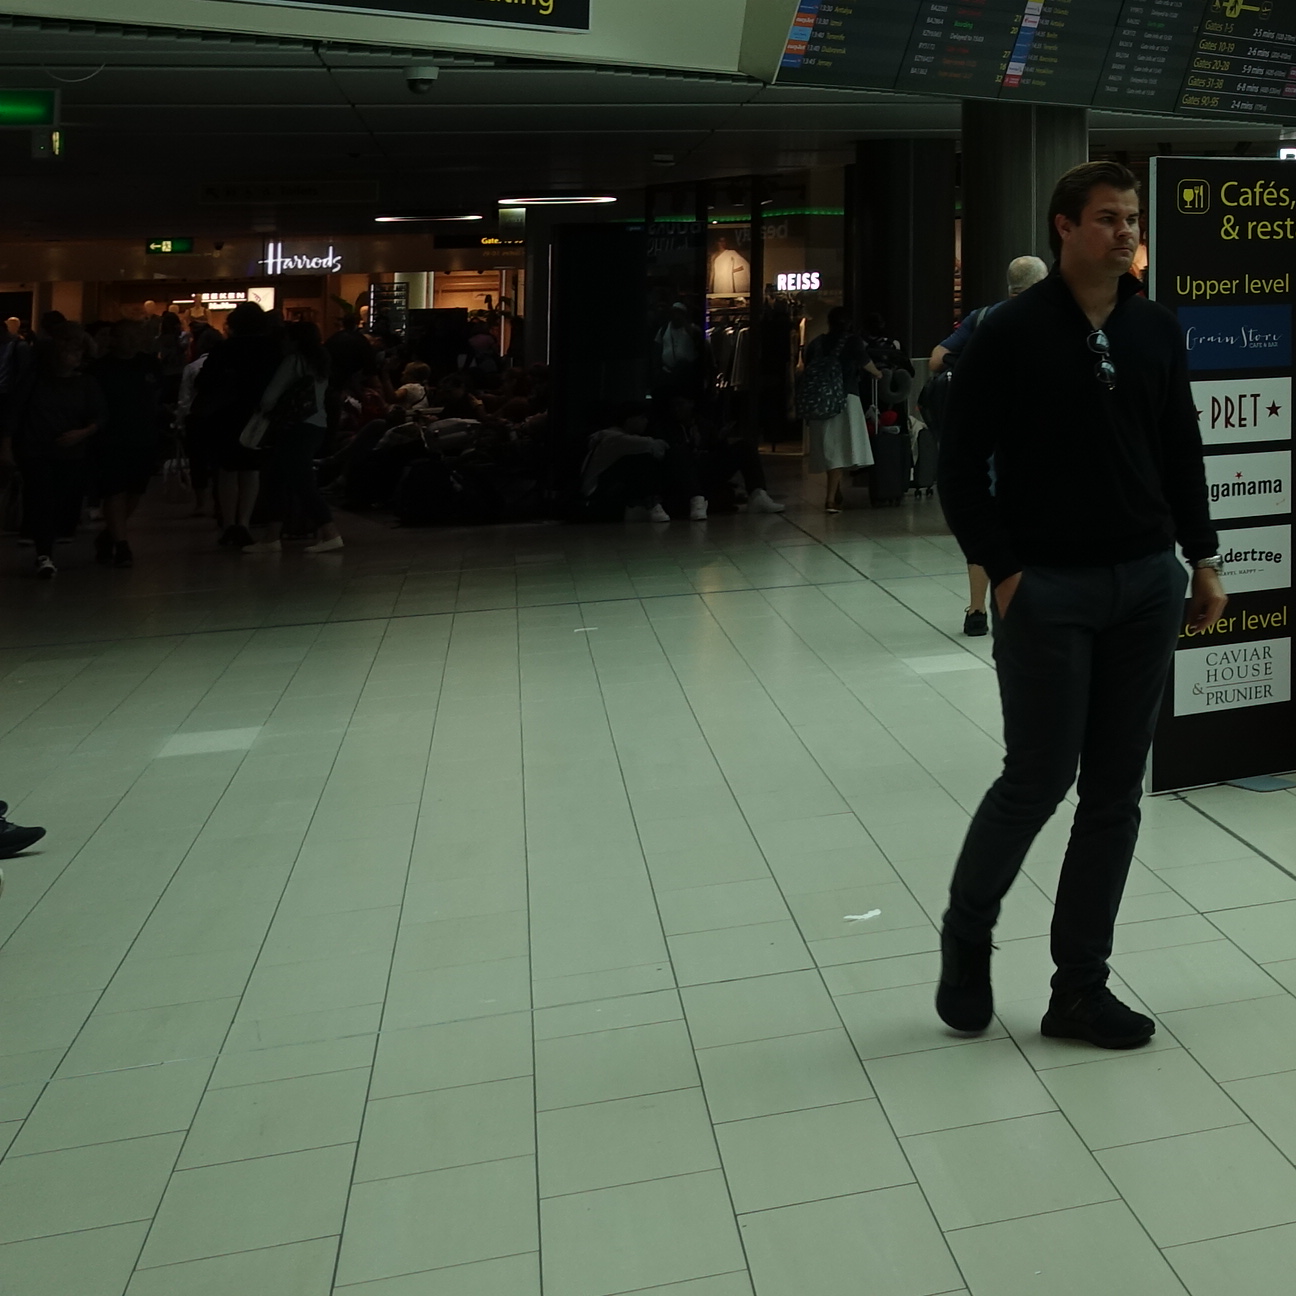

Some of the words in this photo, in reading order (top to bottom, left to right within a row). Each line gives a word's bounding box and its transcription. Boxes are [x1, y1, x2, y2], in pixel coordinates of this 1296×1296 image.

[1205, 19, 1223, 32] Gates
[1224, 22, 1234, 33] 1-5
[1199, 38, 1217, 50] Gates
[1219, 40, 1235, 53] 10-19
[1193, 57, 1211, 69] Gates
[1212, 59, 1230, 71] 20-28
[1188, 76, 1206, 87] Gates
[1207, 77, 1224, 89] 31-38
[1182, 94, 1200, 105] Gates
[1201, 95, 1219, 107] 90-95
[1220, 180, 1296, 210] Cafés,
[1221, 215, 1239, 240] &
[258, 241, 342, 275] Harrods
[777, 272, 822, 291] REISS
[1176, 275, 1239, 300] Upper
[1245, 273, 1290, 294] level
[1239, 325, 1283, 349] Store
[1211, 393, 1261, 429] PRET
[1206, 479, 1282, 501] gamama
[1221, 549, 1282, 564] dertree
[1242, 606, 1287, 630] level
[1206, 645, 1273, 666] CAVIAR
[1206, 661, 1273, 683] HOUSE
[1192, 682, 1204, 696] &
[1206, 684, 1273, 706] PRUNIER
